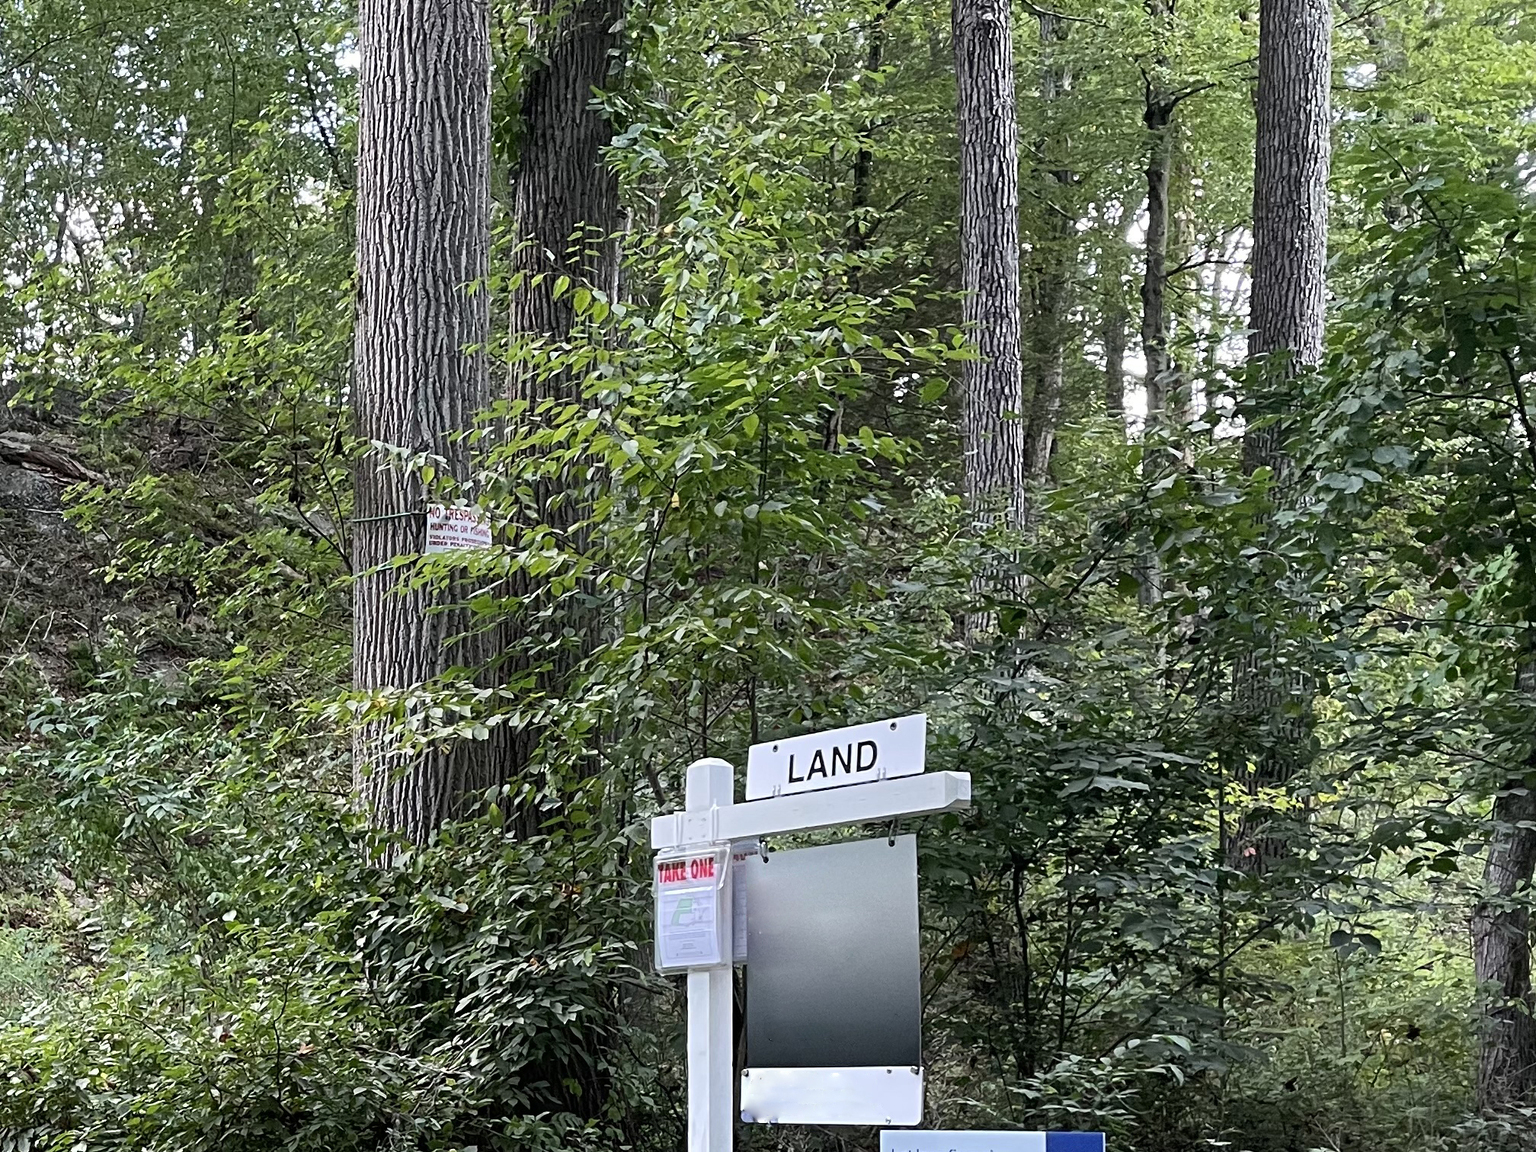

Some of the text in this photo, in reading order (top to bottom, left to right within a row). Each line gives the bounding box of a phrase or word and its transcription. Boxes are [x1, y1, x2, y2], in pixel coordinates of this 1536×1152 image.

[429, 506, 441, 519] NO
[430, 522, 489, 539] HUNTING OR FISHING
[787, 740, 878, 784] LAND
[658, 857, 714, 883] TAKE ONE
